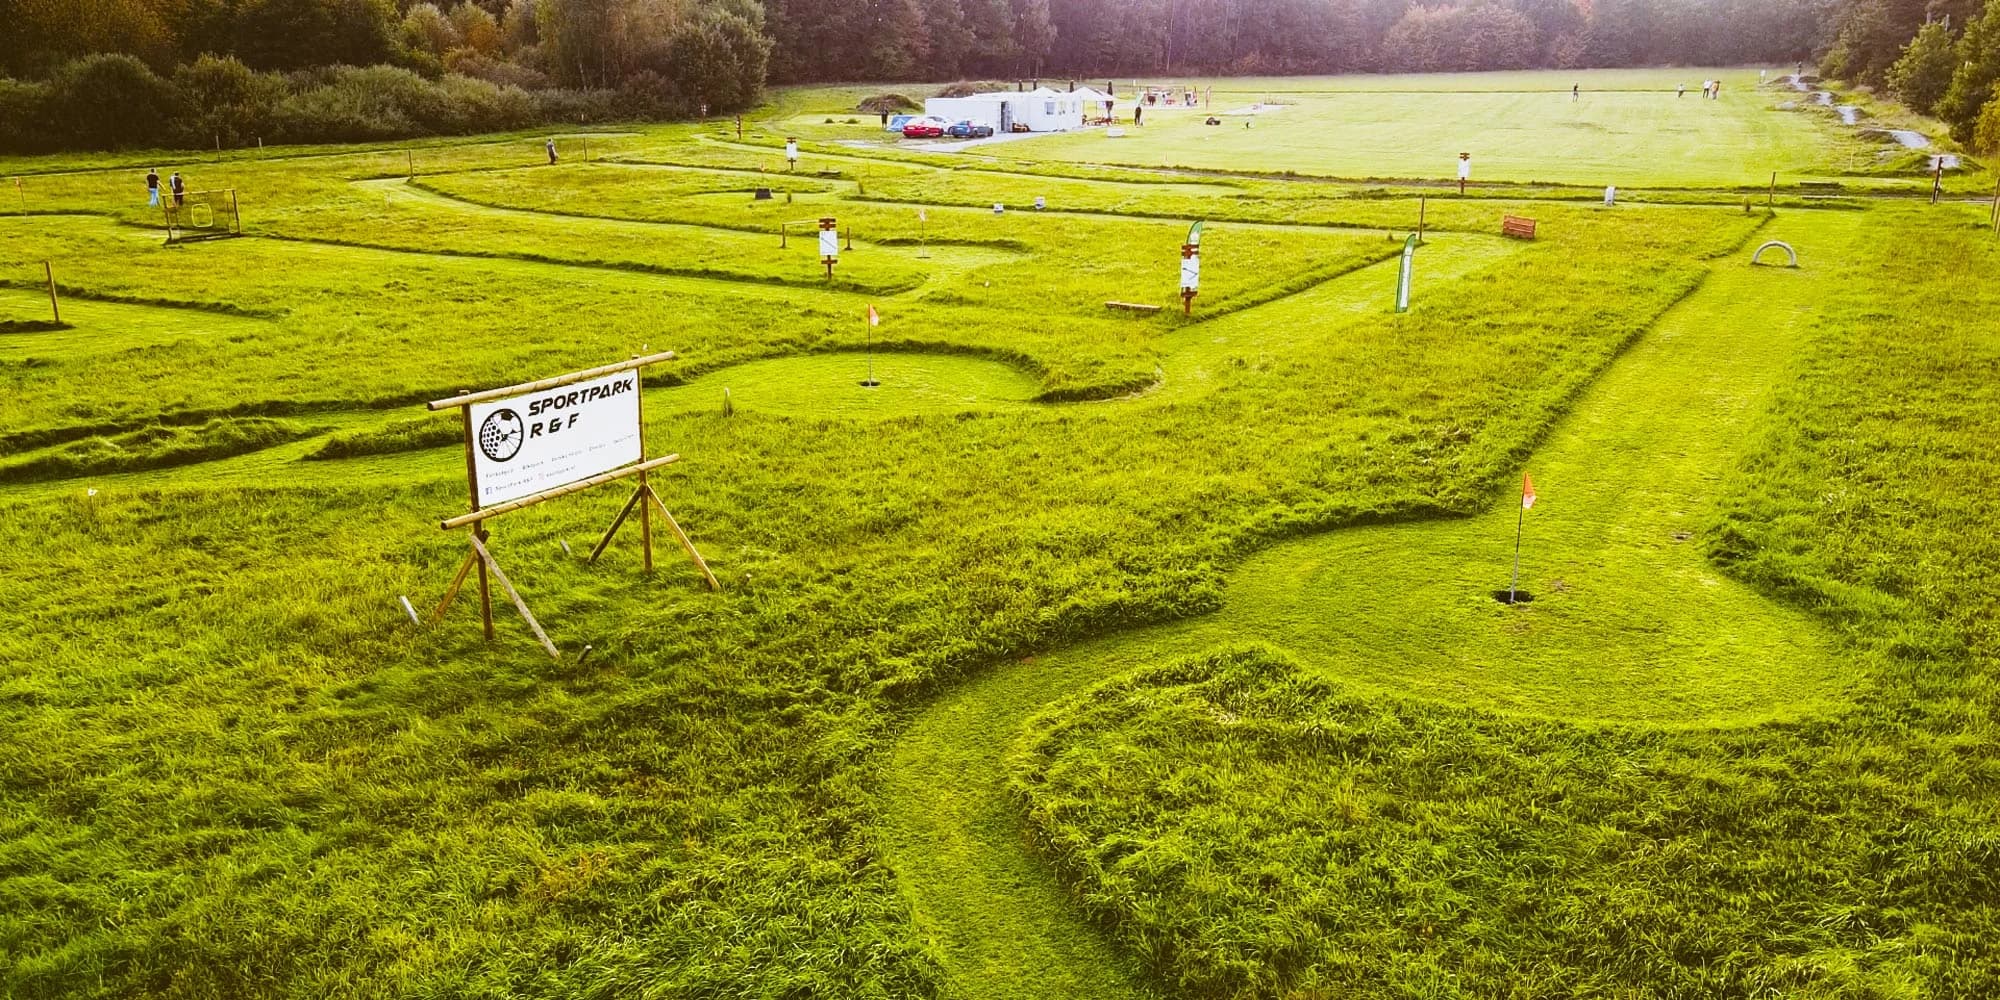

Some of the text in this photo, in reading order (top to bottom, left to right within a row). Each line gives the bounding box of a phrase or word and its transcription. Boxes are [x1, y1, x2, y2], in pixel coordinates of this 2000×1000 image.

[528, 377, 634, 417] SPORTPARK
[529, 412, 580, 439] R & F
